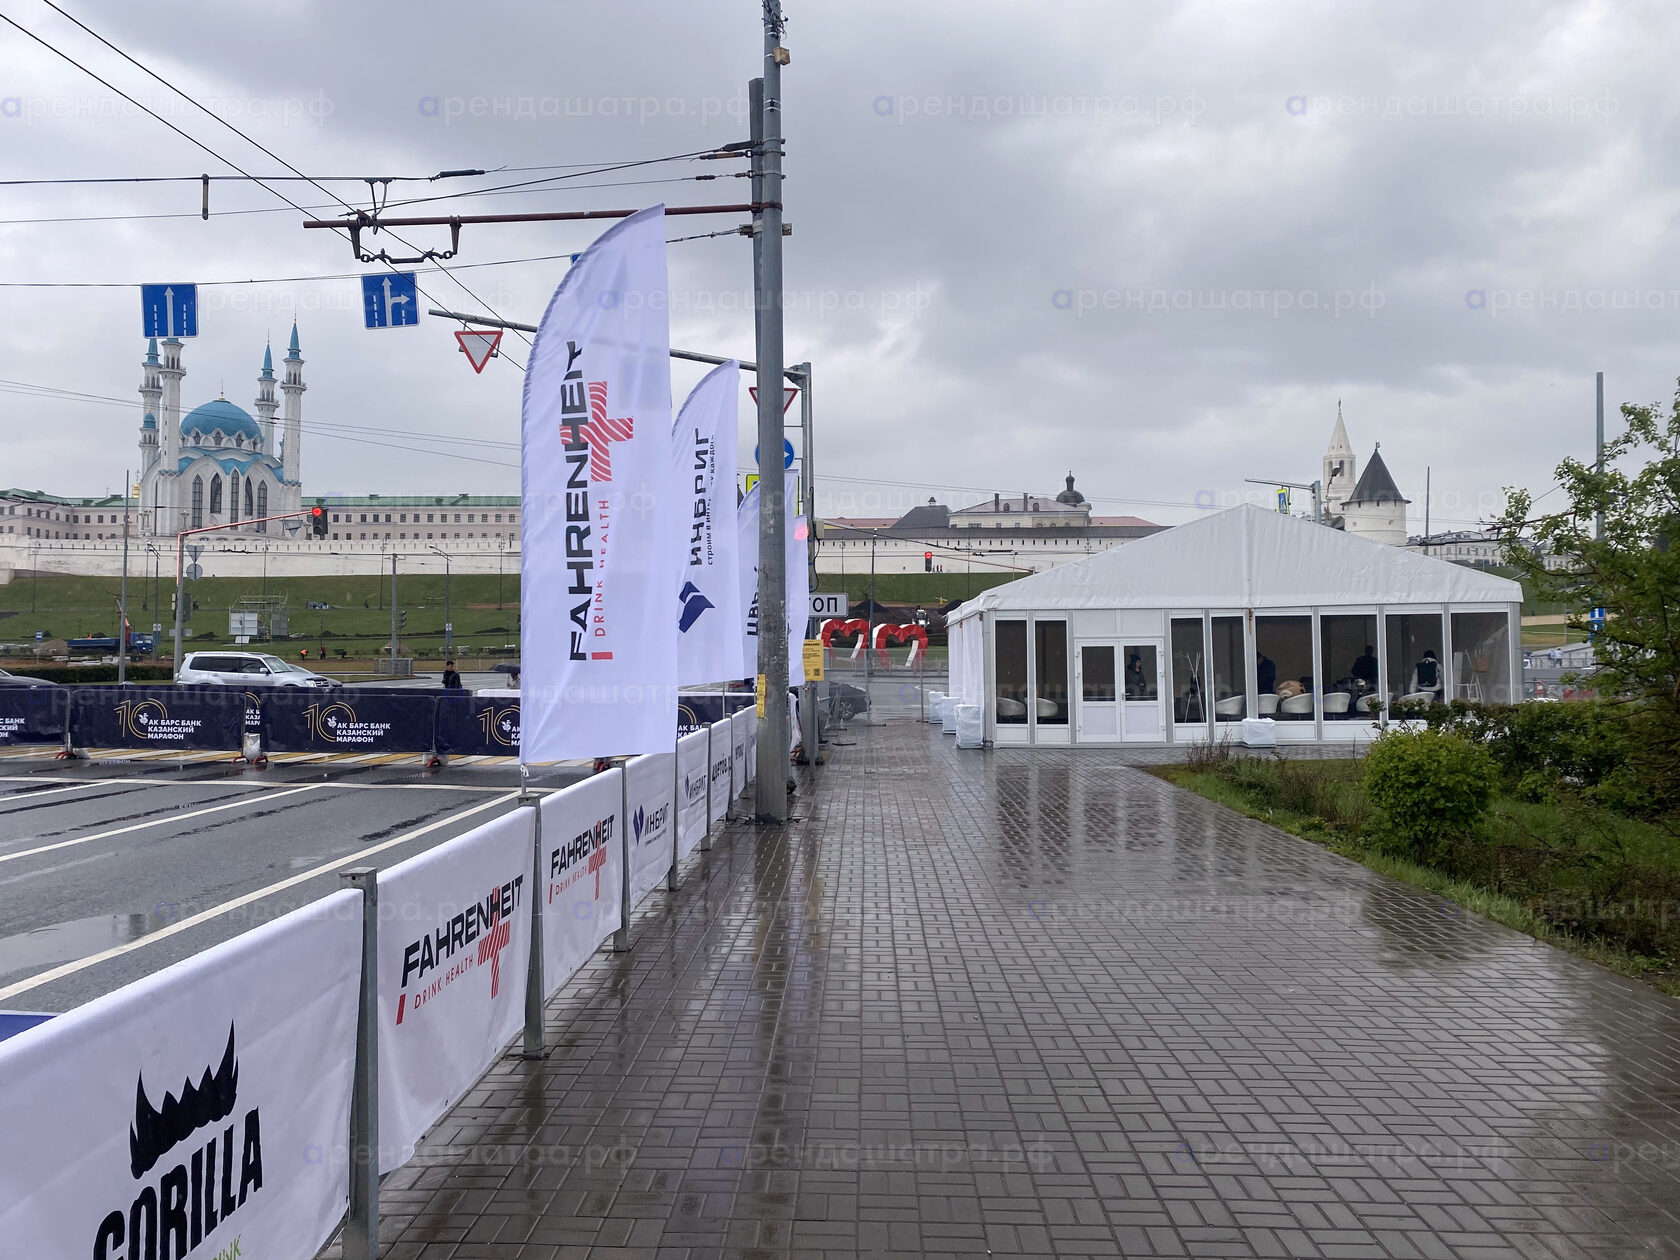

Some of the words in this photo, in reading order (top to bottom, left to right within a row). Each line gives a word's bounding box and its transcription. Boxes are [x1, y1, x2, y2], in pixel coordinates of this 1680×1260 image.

[690, 428, 709, 566] ИНБРИГ
[594, 580, 606, 637] DRINK
[809, 597, 838, 613] ОП
[147, 725, 195, 733] КАЗАНСКИЙ
[336, 728, 384, 736] КАЗАНСКИЙ
[551, 814, 615, 879] FAHRENHEIT
[401, 873, 524, 989] FAHRENHEIT
[414, 977, 442, 1010] DRINK
[445, 953, 474, 987] HEALTH
